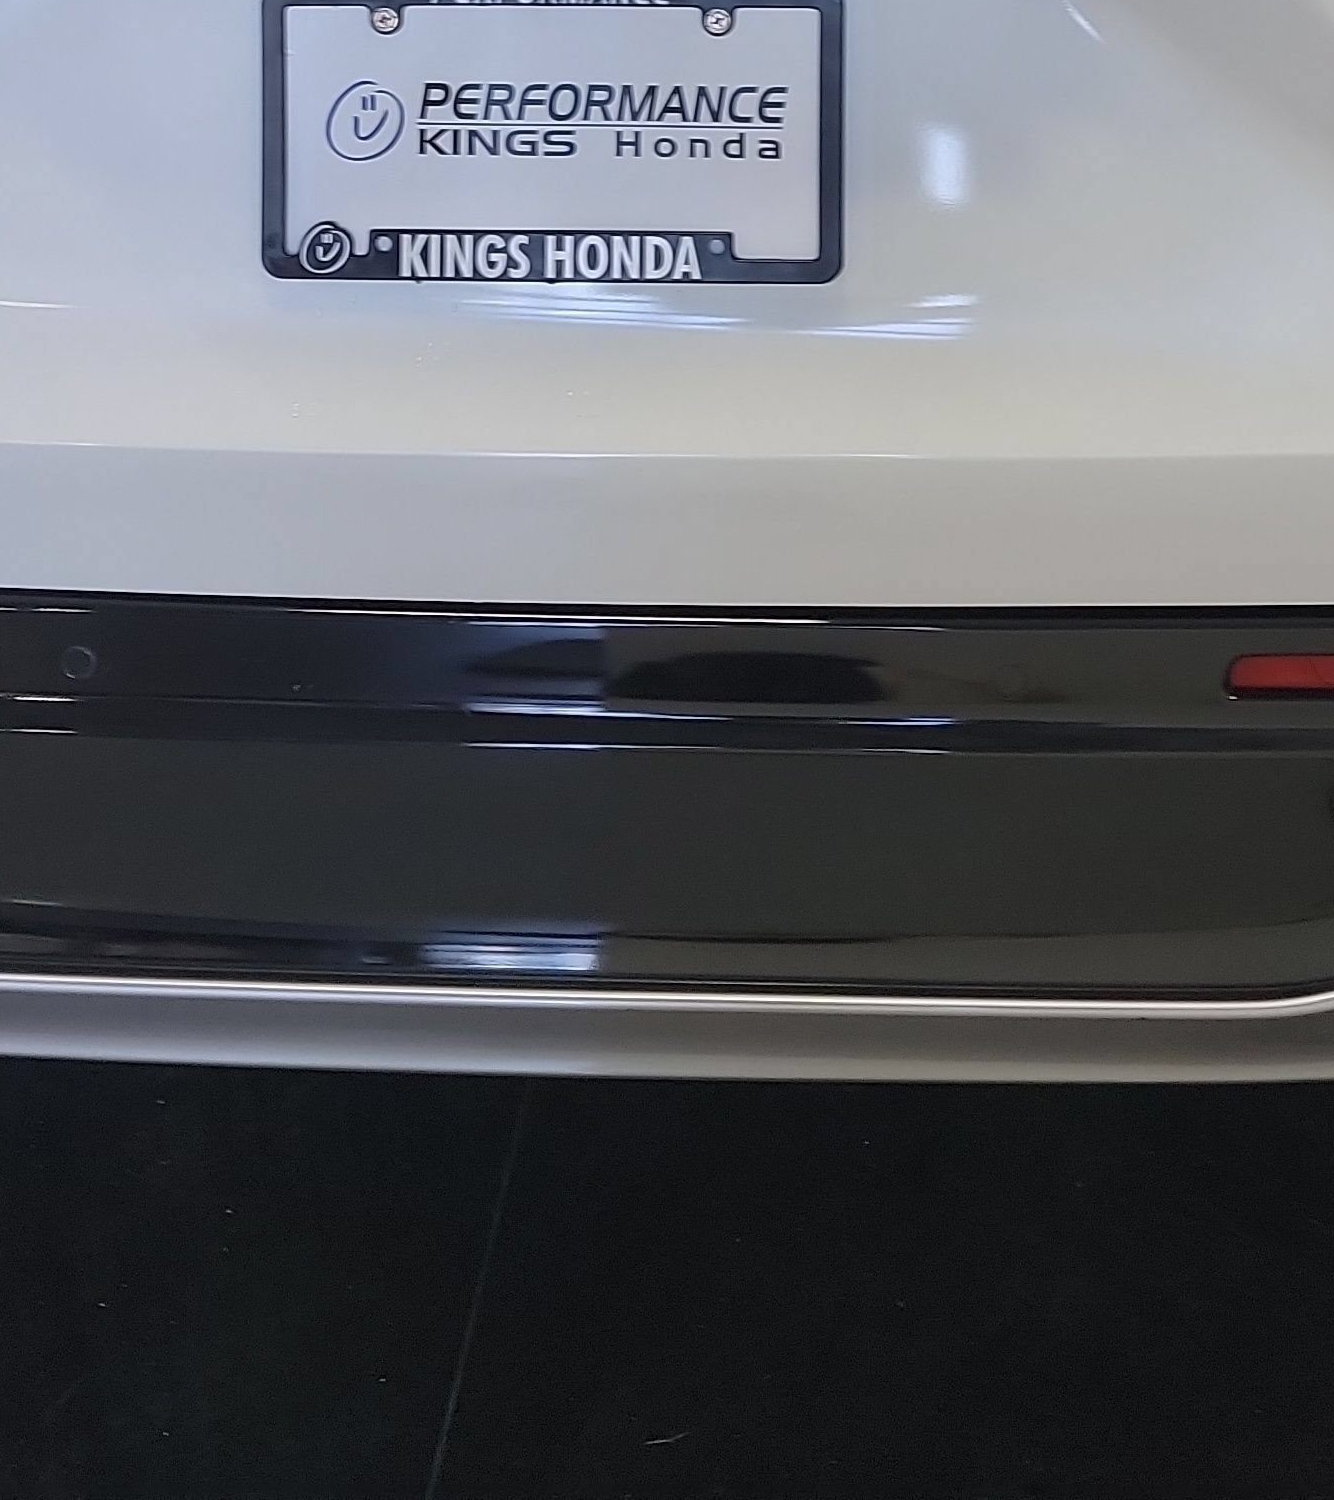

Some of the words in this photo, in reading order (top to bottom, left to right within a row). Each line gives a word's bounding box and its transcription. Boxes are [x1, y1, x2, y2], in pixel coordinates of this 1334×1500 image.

[418, 81, 789, 125] PERFORMANCE
[418, 128, 579, 157] KINGS
[616, 132, 783, 160] Honda
[398, 233, 530, 279] KINGS
[543, 234, 703, 281] HONDA
